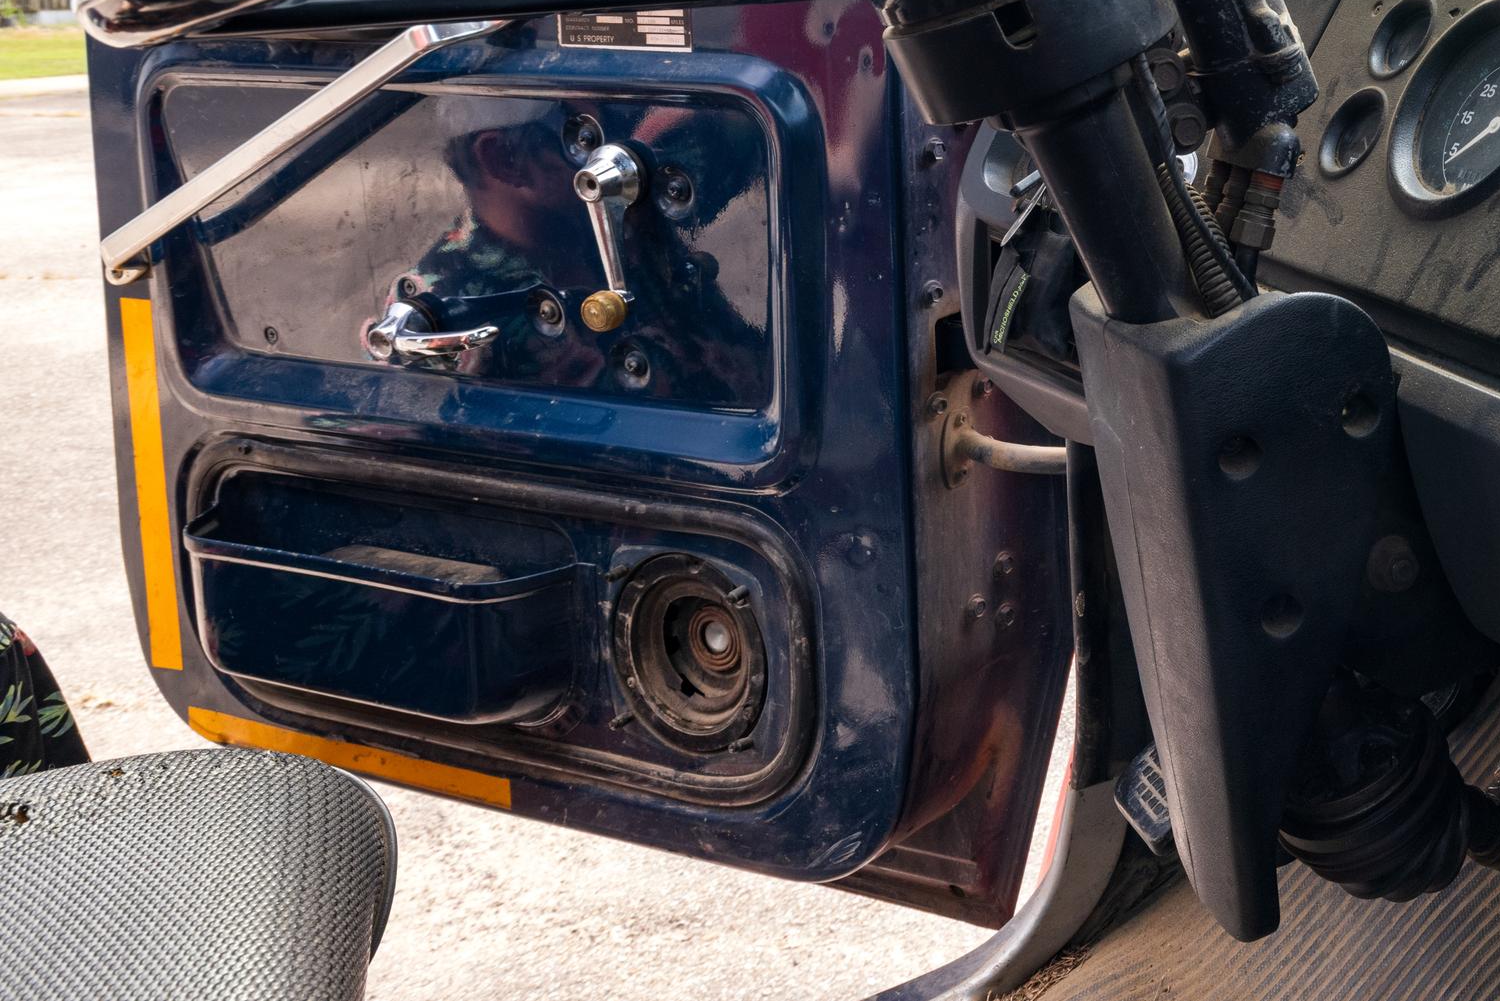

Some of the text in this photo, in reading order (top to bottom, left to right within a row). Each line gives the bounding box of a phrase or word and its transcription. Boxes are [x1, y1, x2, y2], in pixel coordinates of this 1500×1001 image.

[583, 35, 615, 43] PROPERTY
[1480, 83, 1498, 98] 25
[1460, 110, 1475, 125] 15
[1449, 142, 1460, 156] 5
